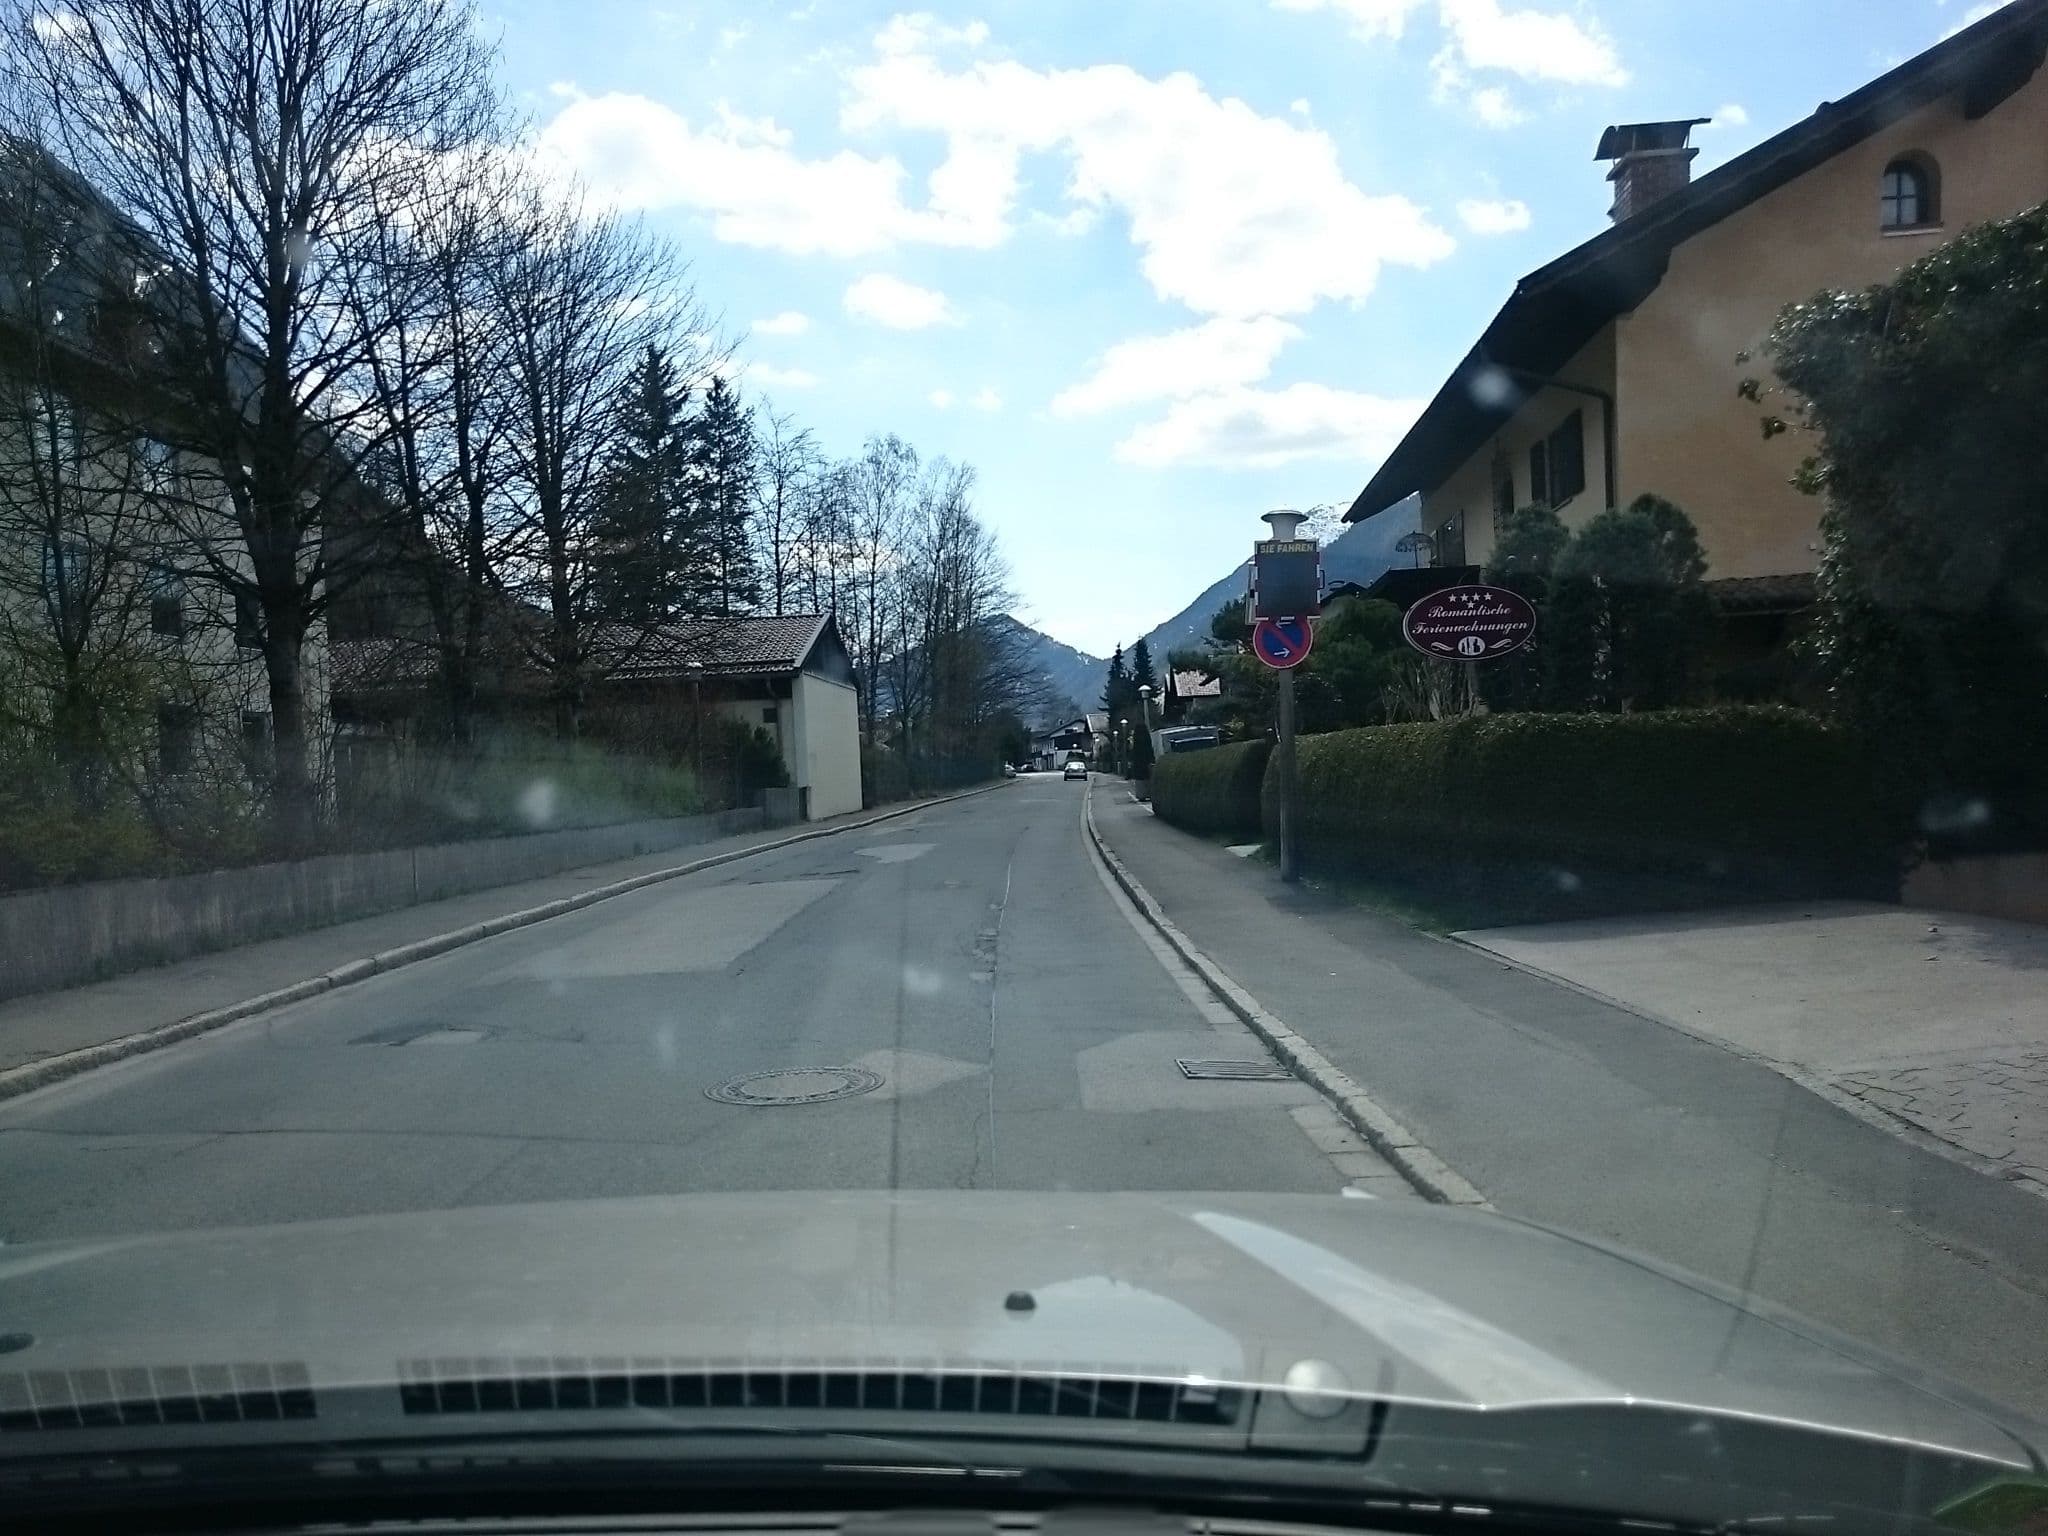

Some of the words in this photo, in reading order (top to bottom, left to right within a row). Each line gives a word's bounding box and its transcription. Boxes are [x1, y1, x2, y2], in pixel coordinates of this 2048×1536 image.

[1277, 543, 1314, 553] FAHREN
[1428, 603, 1512, 618] Romantische
[1412, 620, 1528, 635] Ferienwohnungen
